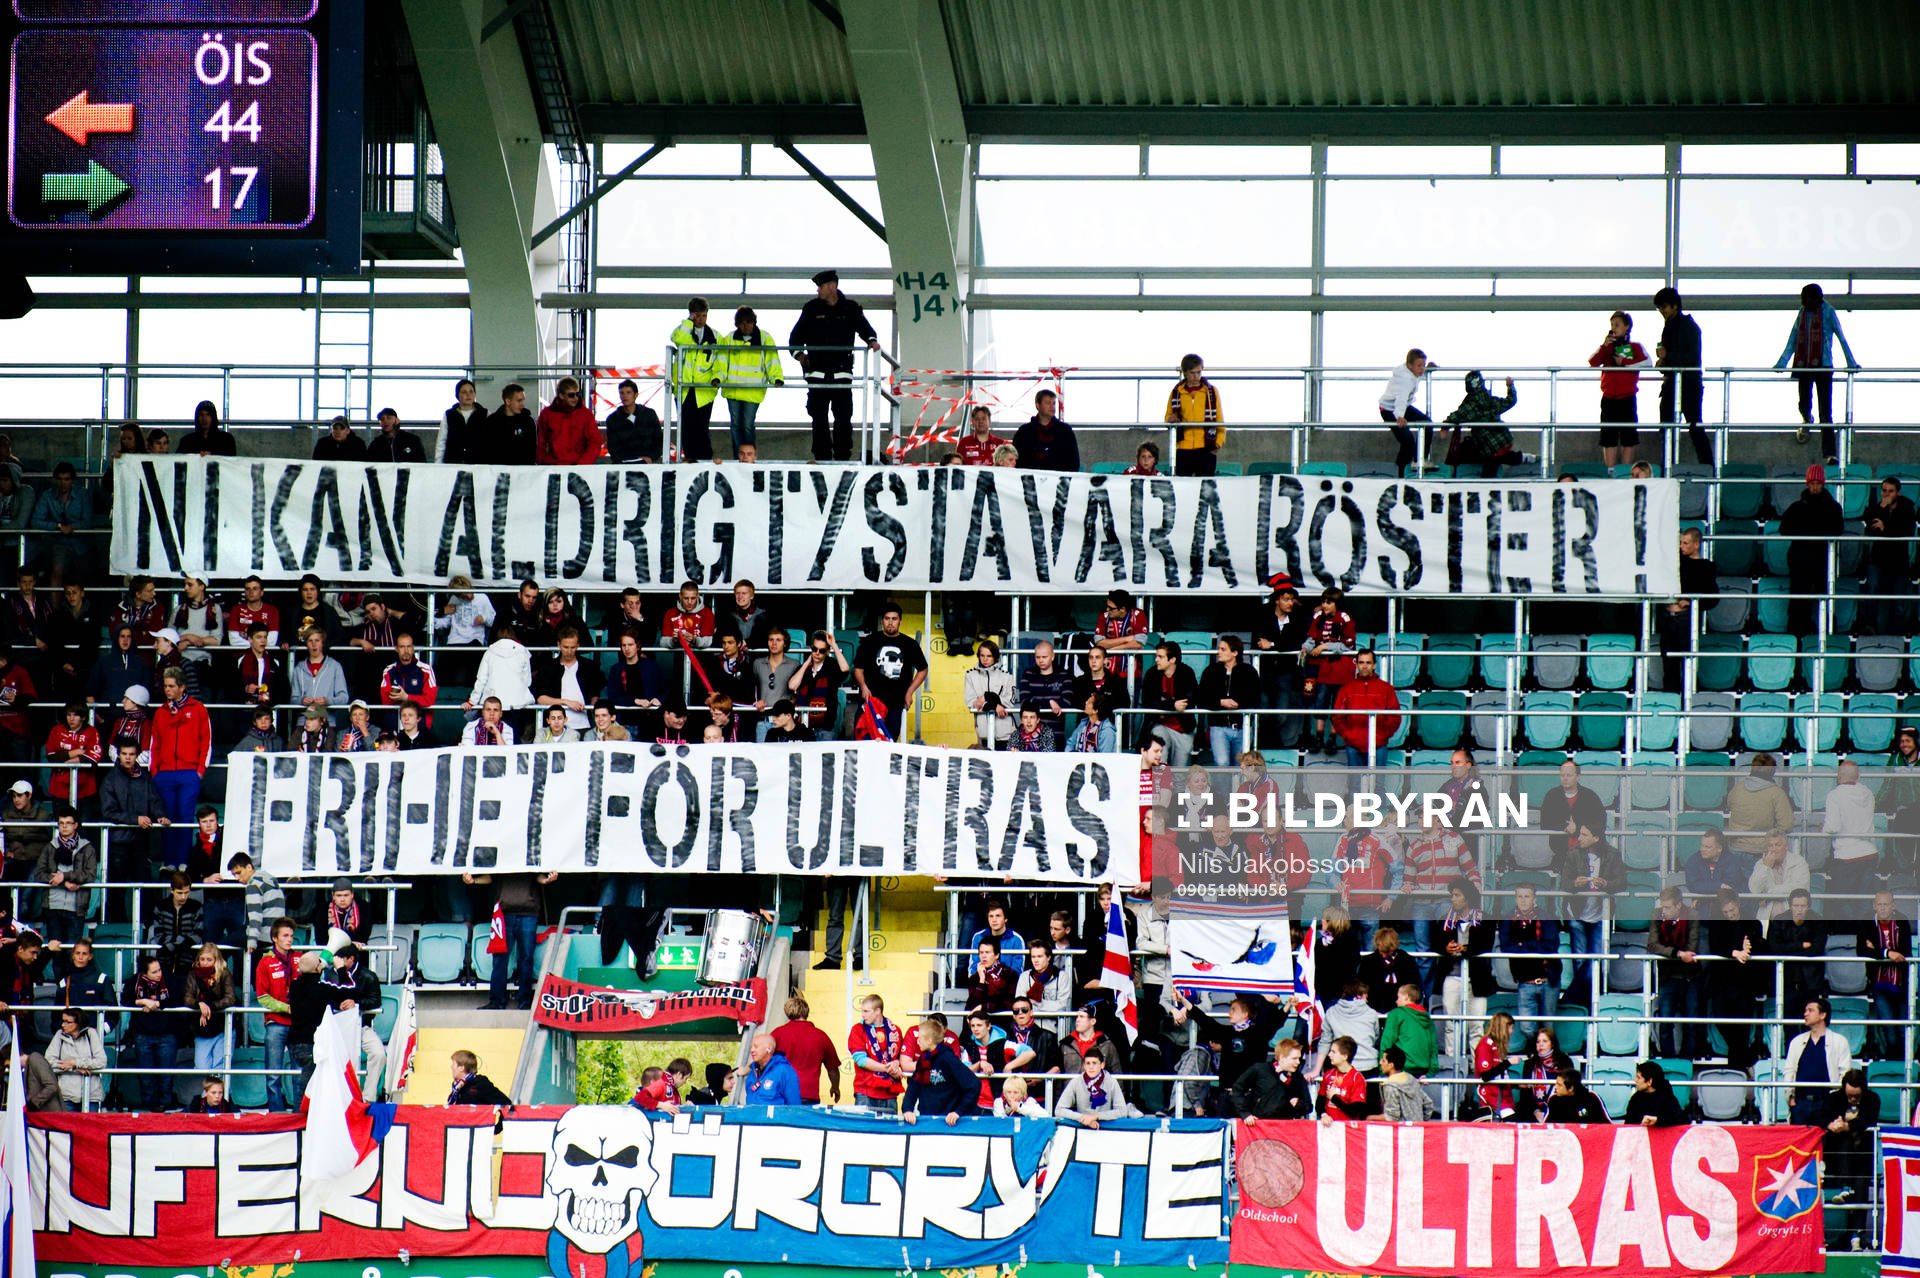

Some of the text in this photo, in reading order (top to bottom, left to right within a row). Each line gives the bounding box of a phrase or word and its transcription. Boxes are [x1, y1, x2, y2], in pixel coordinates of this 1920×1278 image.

[195, 33, 271, 85] ÖIS
[204, 101, 261, 142] 44
[204, 167, 258, 209] 17
[903, 272, 949, 290] H4
[913, 294, 944, 323] J4
[138, 461, 219, 573] NI
[251, 464, 410, 577] KAN
[434, 470, 735, 585] ALDRIG
[753, 467, 1012, 585] TYSTA
[1021, 475, 1238, 588] VÅRA
[248, 743, 1111, 879] FRIHET FÖR ULTRAS
[541, 993, 595, 1015] STOP
[669, 986, 756, 1004] ONTROL
[648, 1112, 1223, 1240] ÖRGRYTE
[1241, 1208, 1298, 1224] Oldschool
[1316, 1124, 1739, 1271] ULTRAS
[1758, 1223, 1799, 1239] Örgryte
